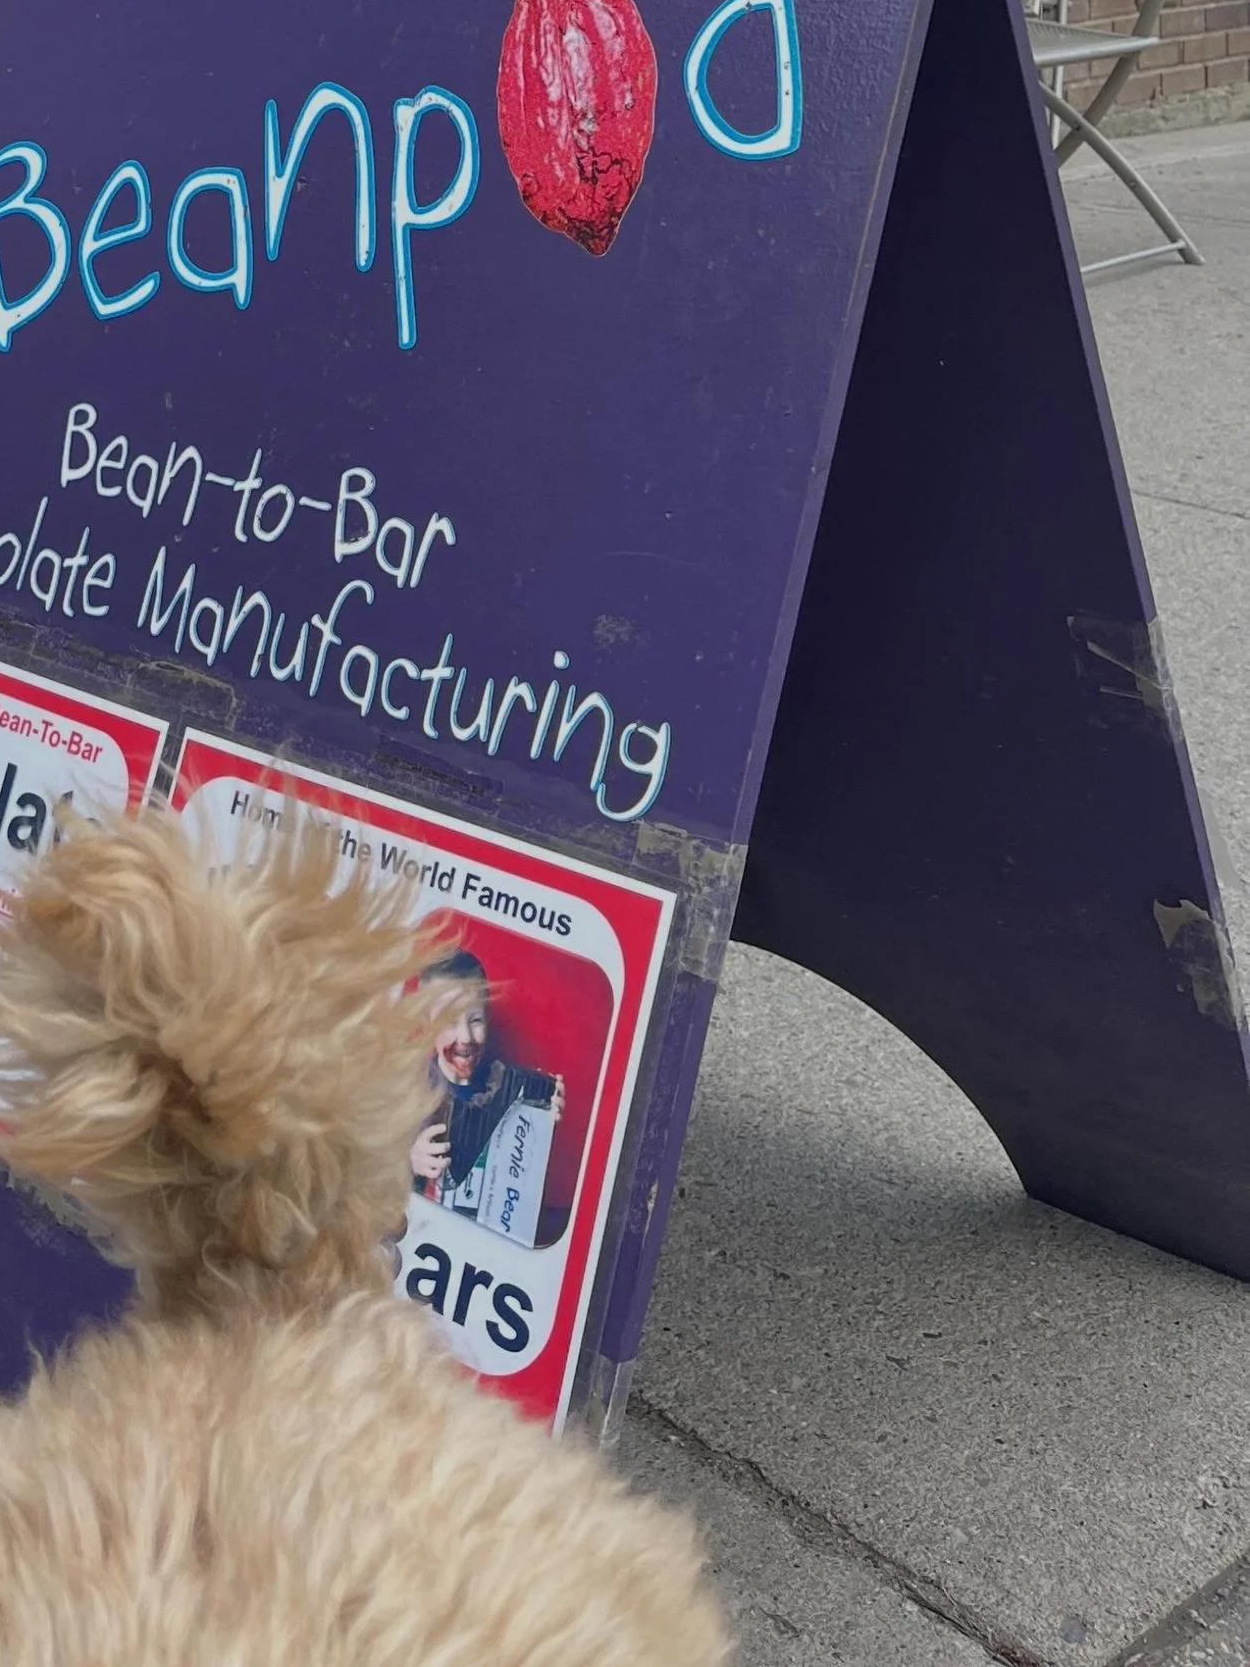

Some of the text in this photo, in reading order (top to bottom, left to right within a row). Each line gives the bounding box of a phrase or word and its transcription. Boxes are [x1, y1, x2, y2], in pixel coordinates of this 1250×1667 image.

[60, 403, 457, 589] Bean-to-Bar
[137, 545, 671, 823] Manufacturing
[230, 790, 284, 830] Hom
[380, 842, 456, 893] World
[461, 872, 573, 937] Famous
[499, 1115, 531, 1233] Fernie Bear
[405, 1243, 534, 1353] ars
